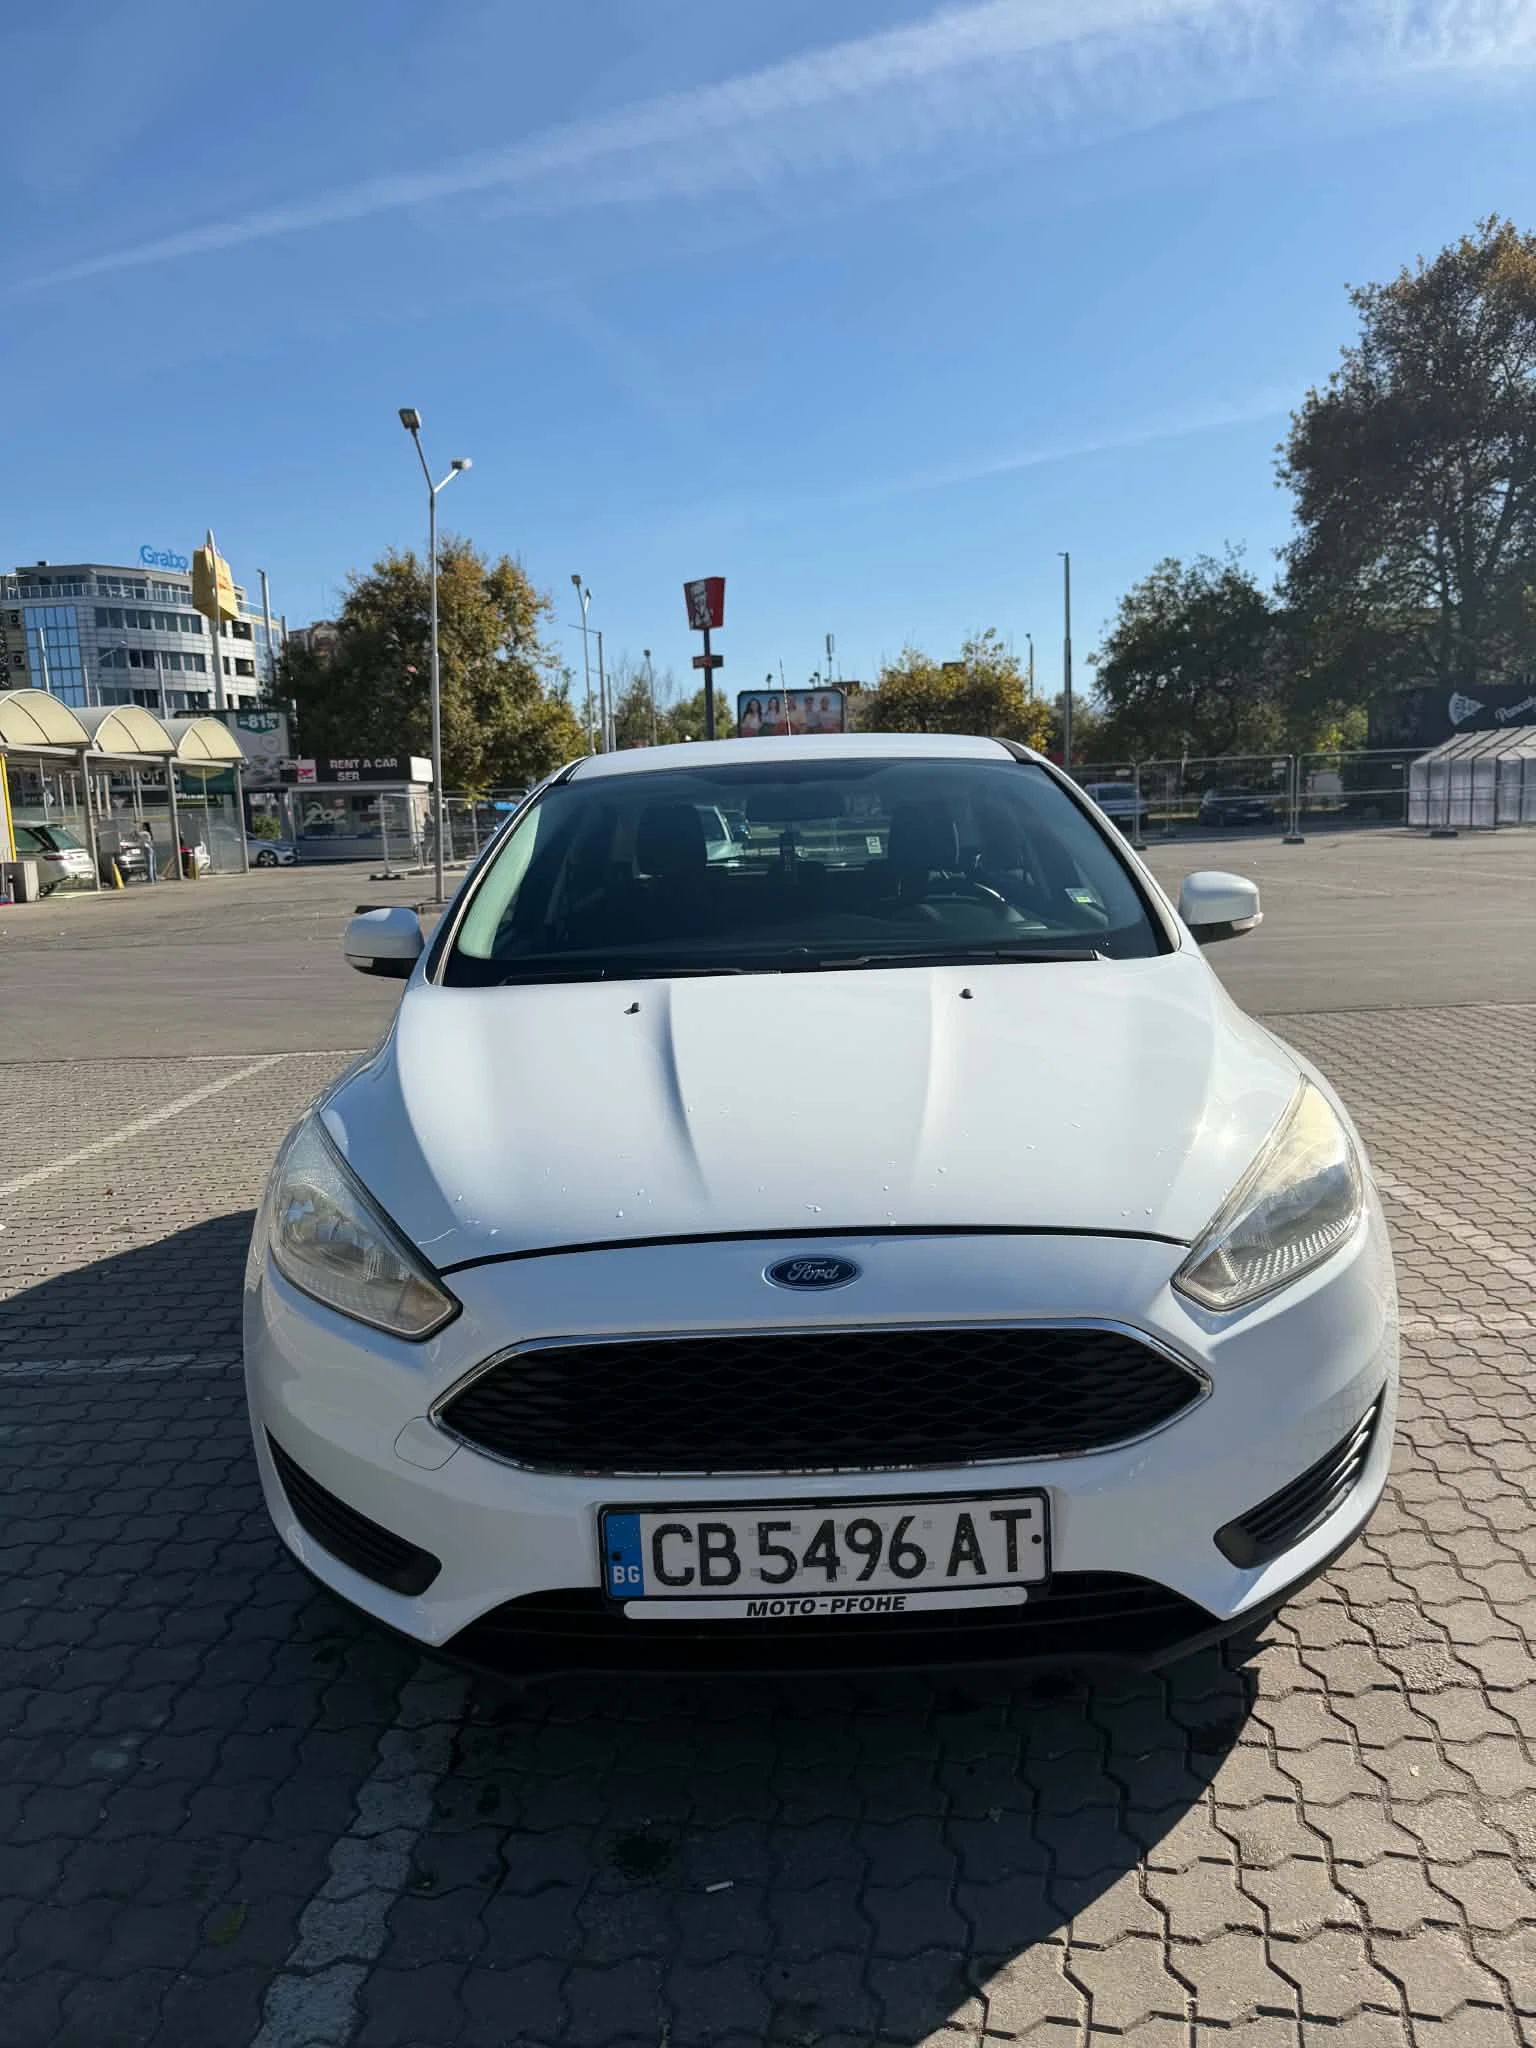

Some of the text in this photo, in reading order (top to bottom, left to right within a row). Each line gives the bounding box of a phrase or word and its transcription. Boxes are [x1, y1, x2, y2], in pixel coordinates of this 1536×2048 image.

[140, 545, 189, 570] Grabo
[329, 757, 398, 769] RENT A CAR
[787, 1260, 840, 1281] Ford
[651, 1508, 1032, 1587] CB 5496 AT
[611, 1565, 641, 1585] BG
